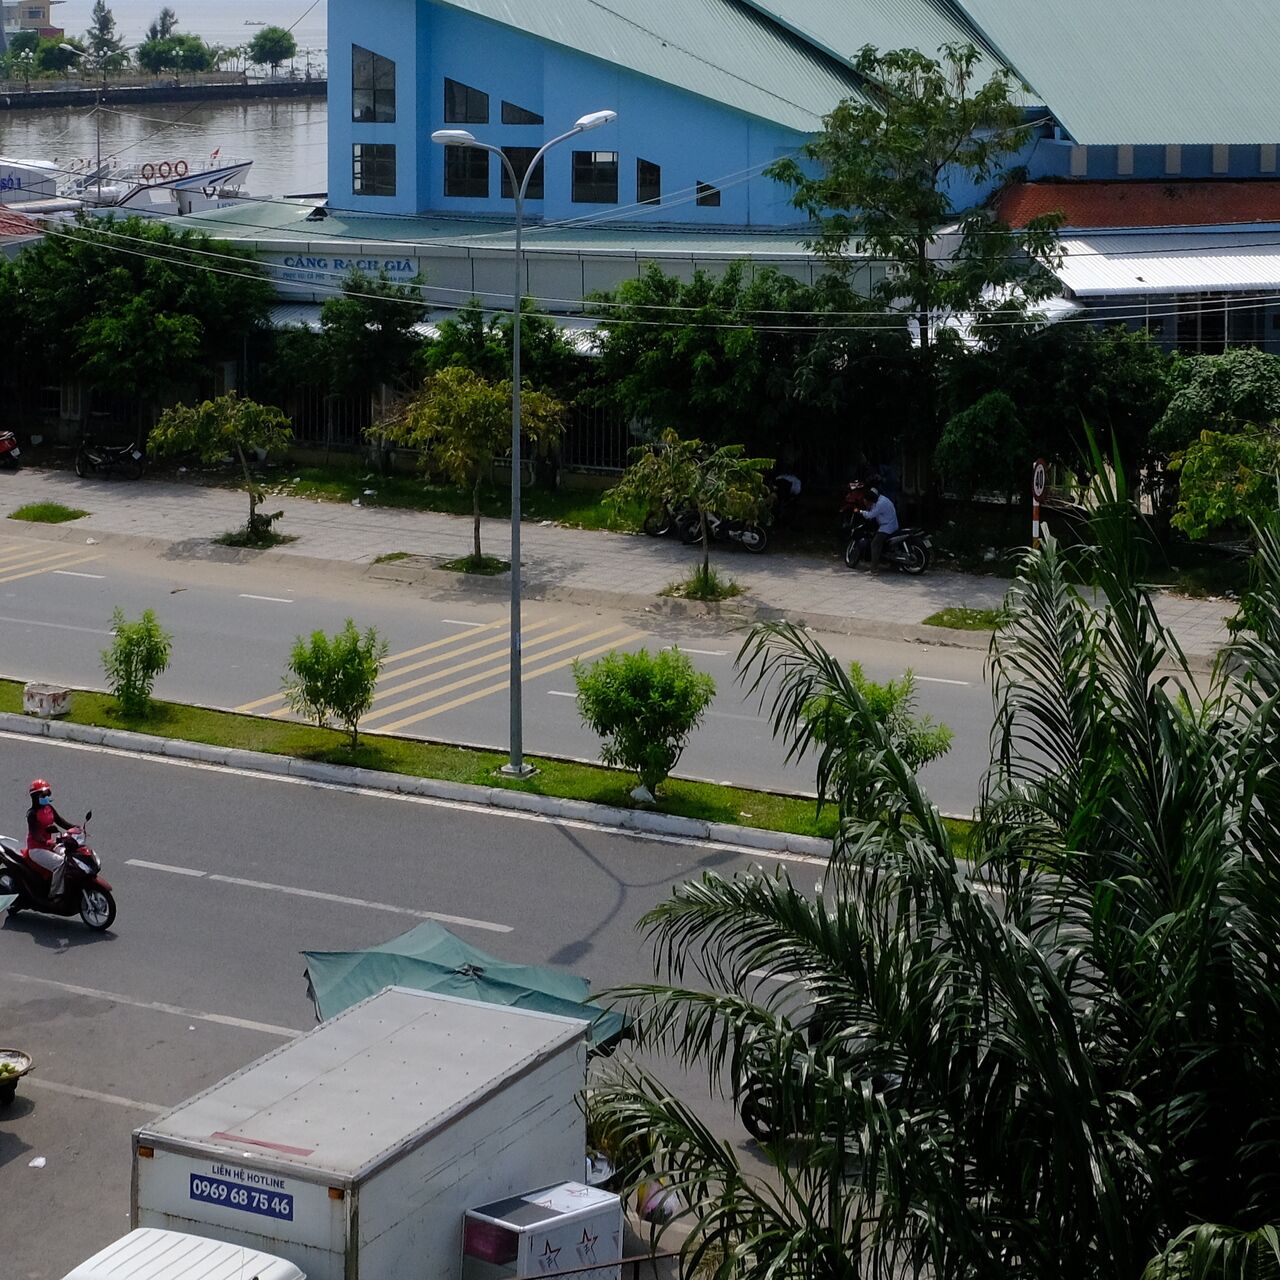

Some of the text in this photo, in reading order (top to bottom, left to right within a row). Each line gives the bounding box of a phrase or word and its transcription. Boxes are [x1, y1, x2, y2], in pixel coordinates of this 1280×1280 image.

[284, 255, 328, 269] CẢNG
[212, 1164, 285, 1189] LIÊN HỆ HOTLINE
[192, 1178, 290, 1214] 0969 68 75 46
